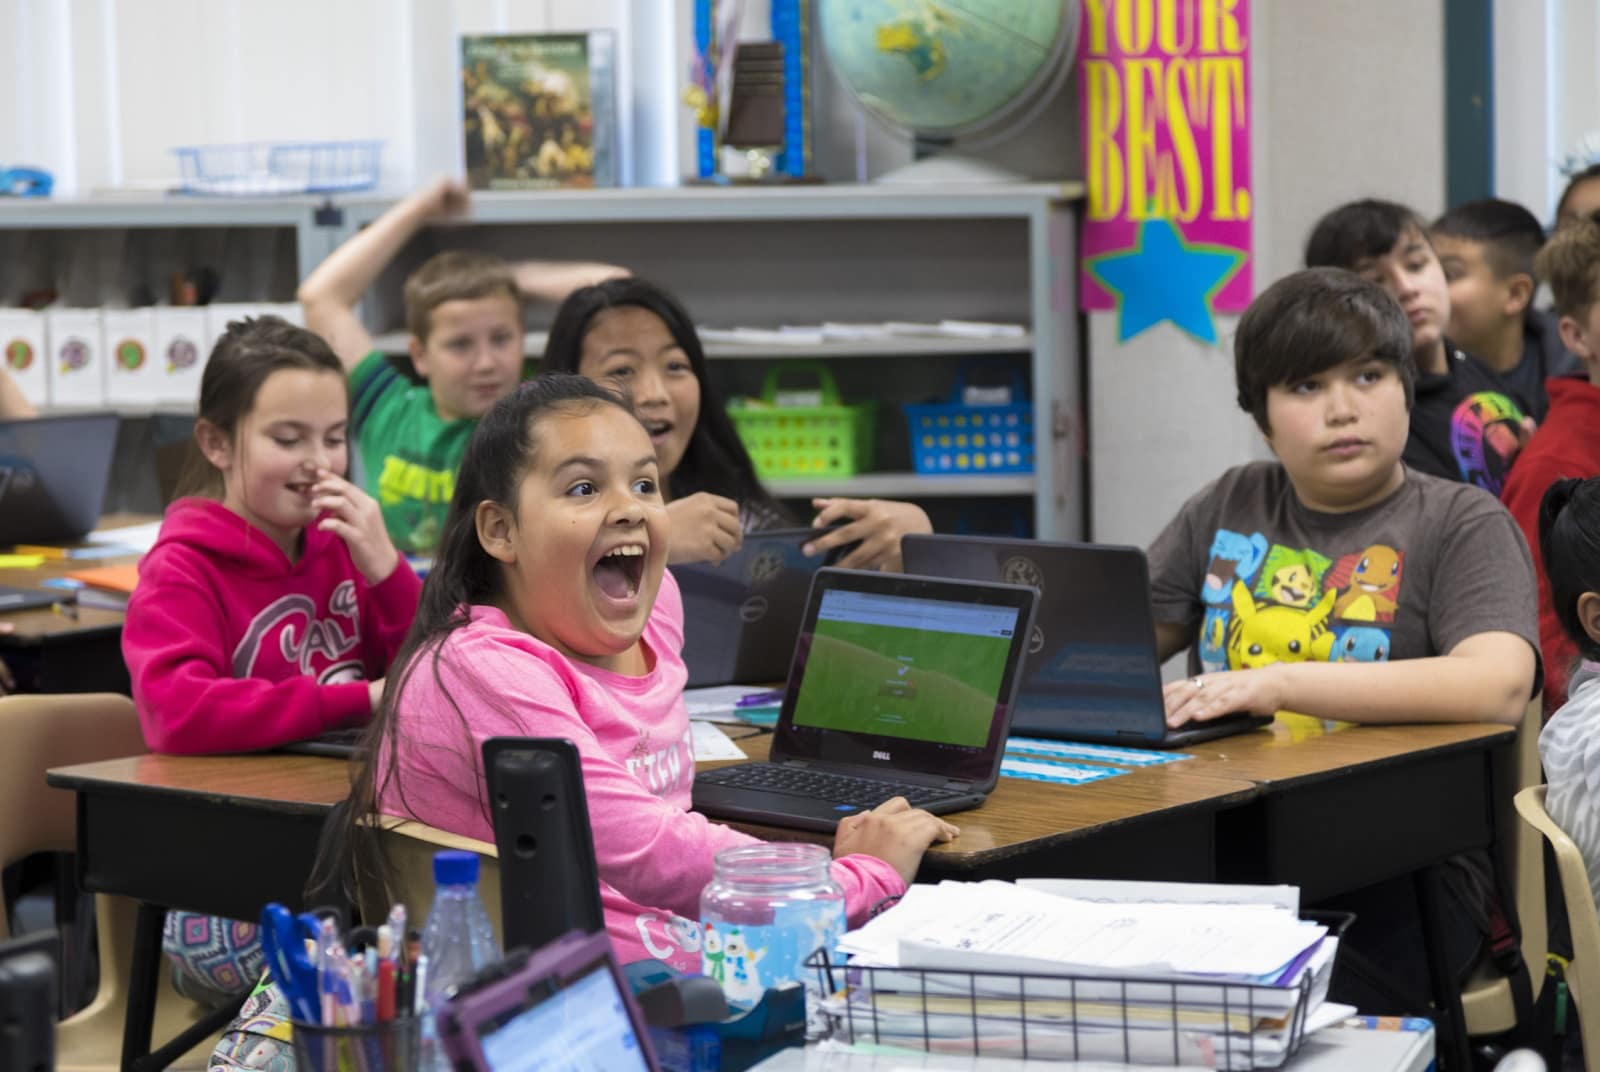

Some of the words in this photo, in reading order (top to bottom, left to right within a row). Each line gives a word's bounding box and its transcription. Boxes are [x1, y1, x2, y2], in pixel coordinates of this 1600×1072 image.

[1083, 0, 1248, 56] YOUR
[1083, 57, 1250, 222] BEST.
[872, 750, 891, 761] DELL
